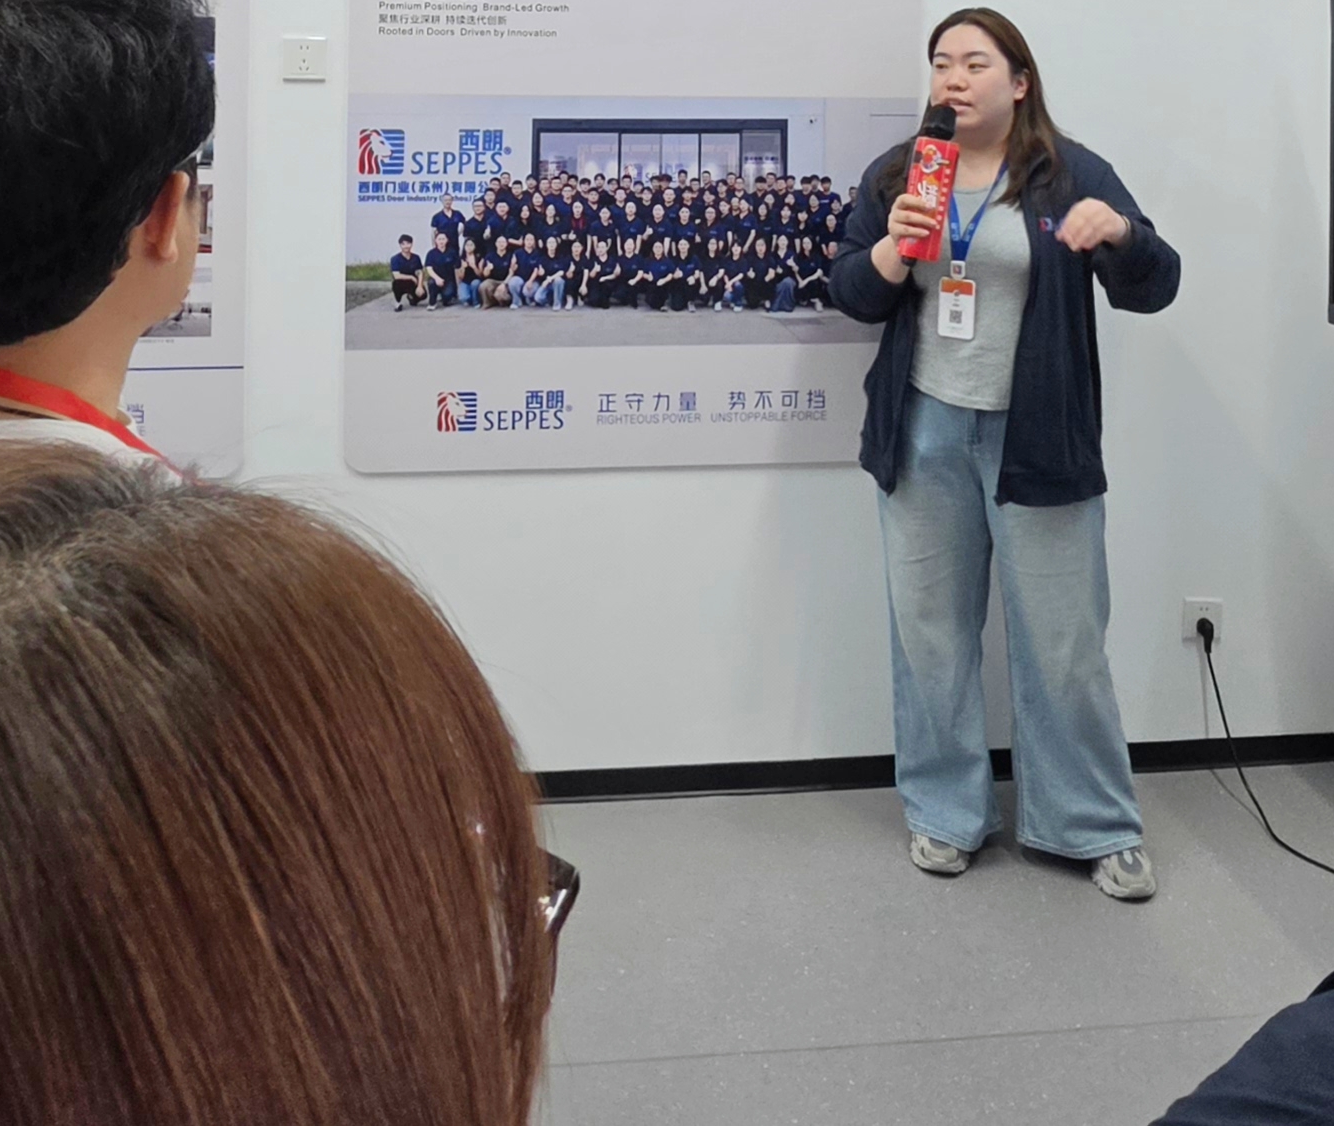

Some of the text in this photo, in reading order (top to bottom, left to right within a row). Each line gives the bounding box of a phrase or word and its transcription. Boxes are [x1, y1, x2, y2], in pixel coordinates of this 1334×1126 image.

[379, 1, 569, 12] Premium Positioning Brand-Led Growth
[459, 129, 503, 151] 西朗
[410, 151, 503, 174] SEPPES
[525, 390, 564, 409] 西朗
[597, 390, 825, 412] 正守力量 势不可挡
[483, 409, 564, 431] SEPPES
[596, 408, 827, 424] RIGHTEOUS POWER UNSTOPPABLE FORCE
